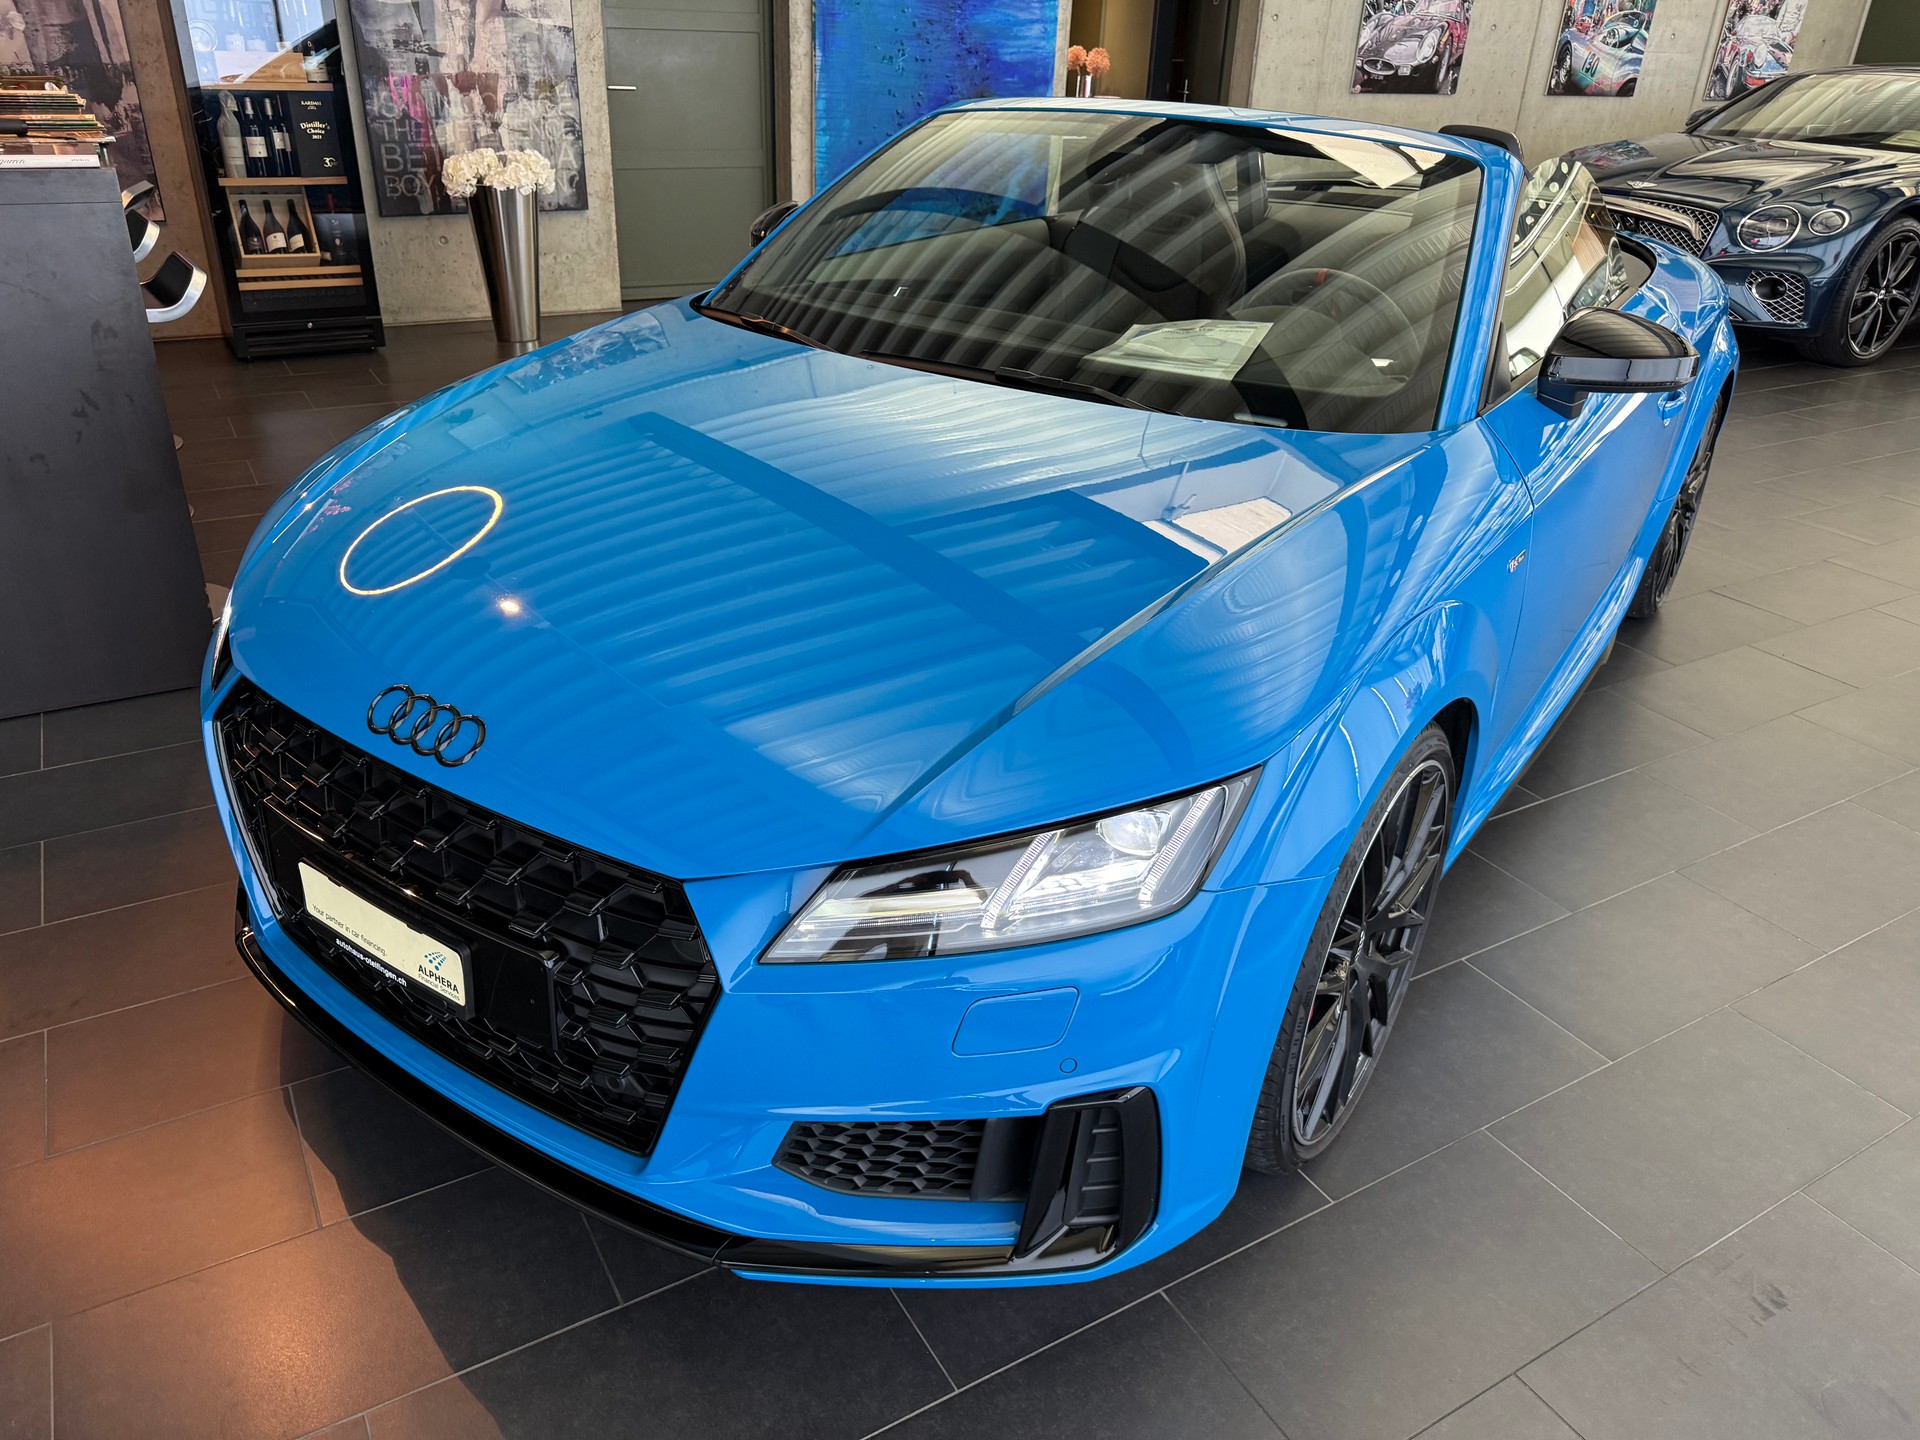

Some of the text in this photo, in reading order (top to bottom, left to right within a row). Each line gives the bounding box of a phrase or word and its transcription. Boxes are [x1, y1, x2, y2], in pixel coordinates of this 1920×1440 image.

[312, 904, 388, 957] Your partner in car financing.
[418, 964, 460, 995] ALPHERA
[418, 973, 461, 1002] Financial Services
